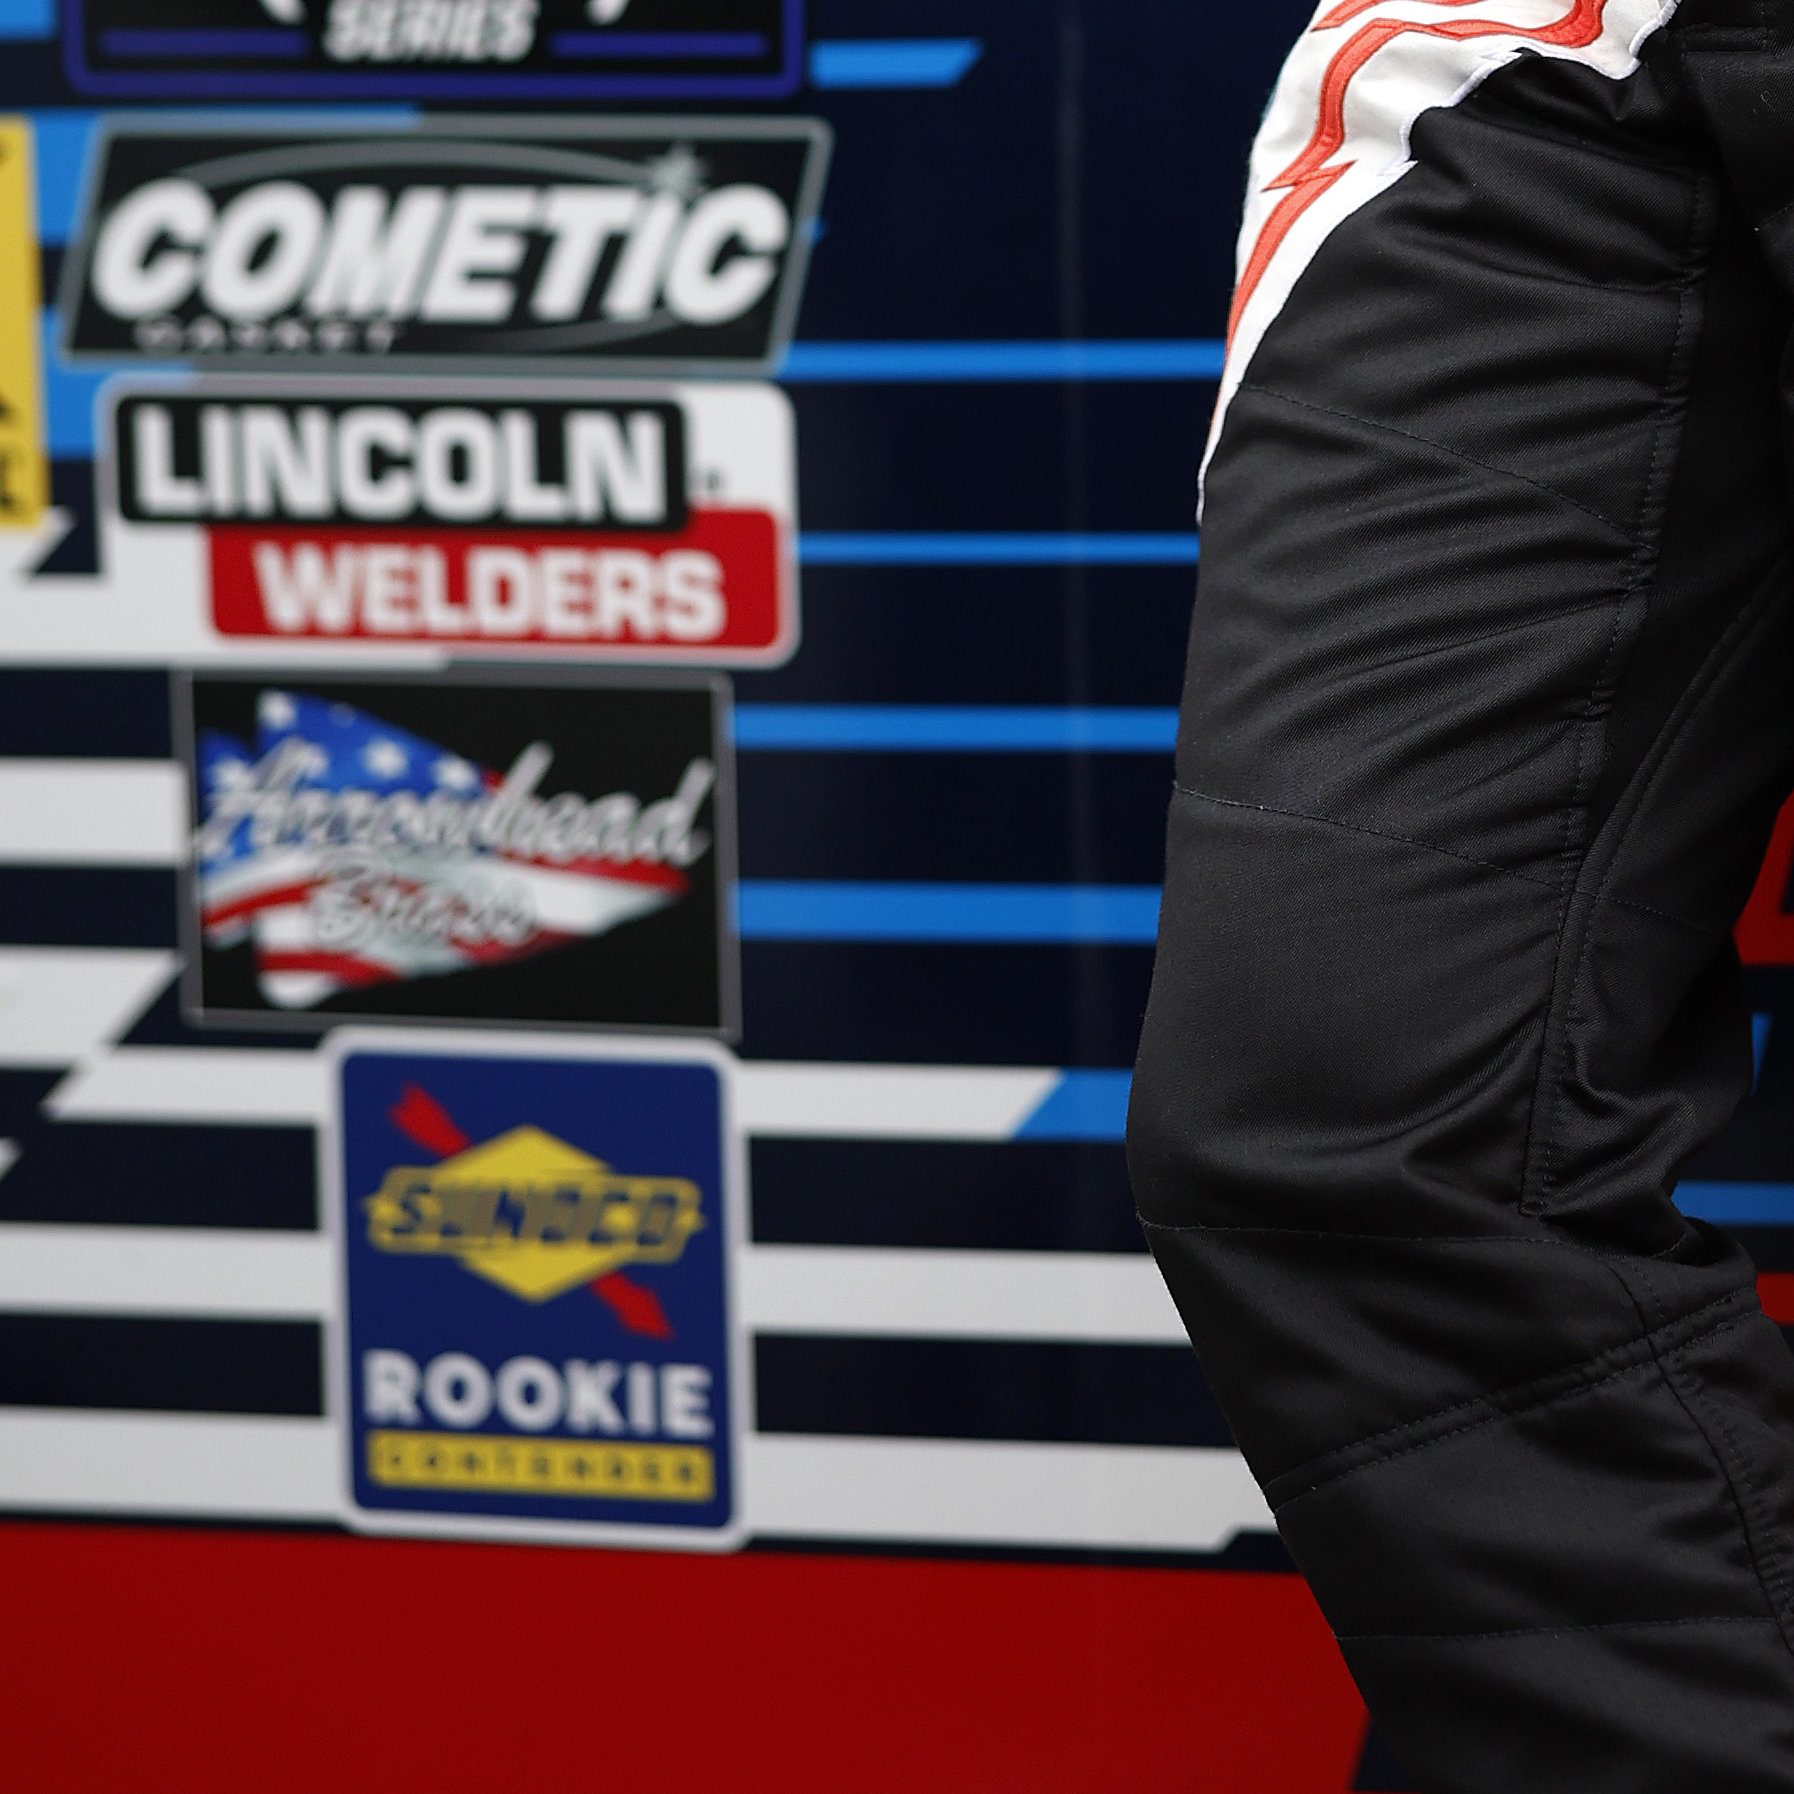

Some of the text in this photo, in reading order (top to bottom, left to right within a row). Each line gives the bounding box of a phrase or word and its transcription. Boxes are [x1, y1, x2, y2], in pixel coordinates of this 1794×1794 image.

[90, 175, 790, 326] COMETIC
[132, 399, 670, 524] LINCOLN
[254, 540, 730, 640] WELDERS
[362, 1346, 716, 1440] ROOKIE
